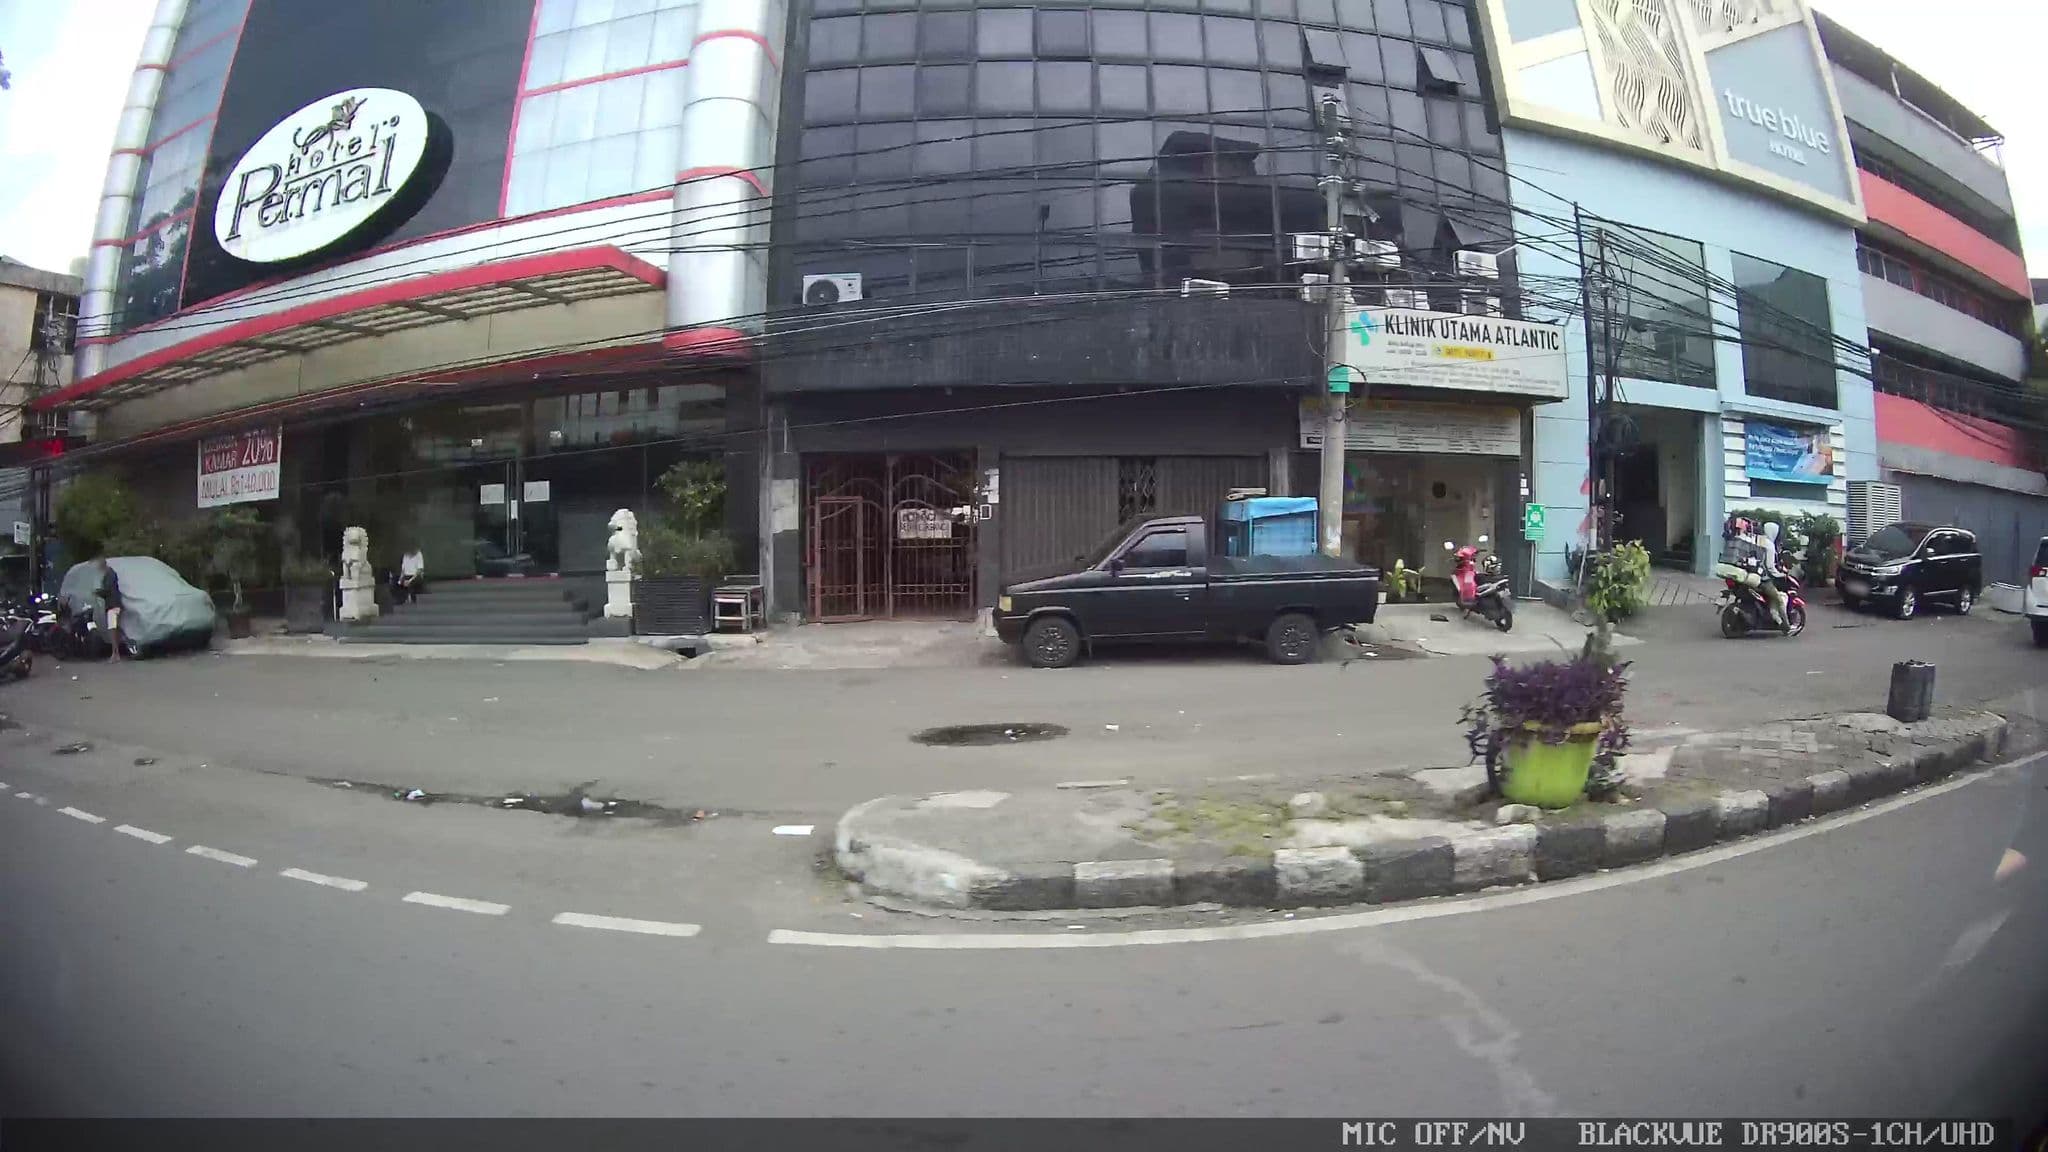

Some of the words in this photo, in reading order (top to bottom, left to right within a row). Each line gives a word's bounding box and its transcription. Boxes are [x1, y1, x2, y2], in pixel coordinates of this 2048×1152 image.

[1723, 88, 1778, 132] true
[1778, 107, 1831, 155] blue
[285, 123, 379, 178] hotel
[1384, 314, 1437, 339] KLINIK
[1440, 318, 1493, 344] UTAMA
[1495, 325, 1560, 351] ATLANTIC
[204, 449, 239, 473] KAMAR
[242, 430, 274, 466] 20%
